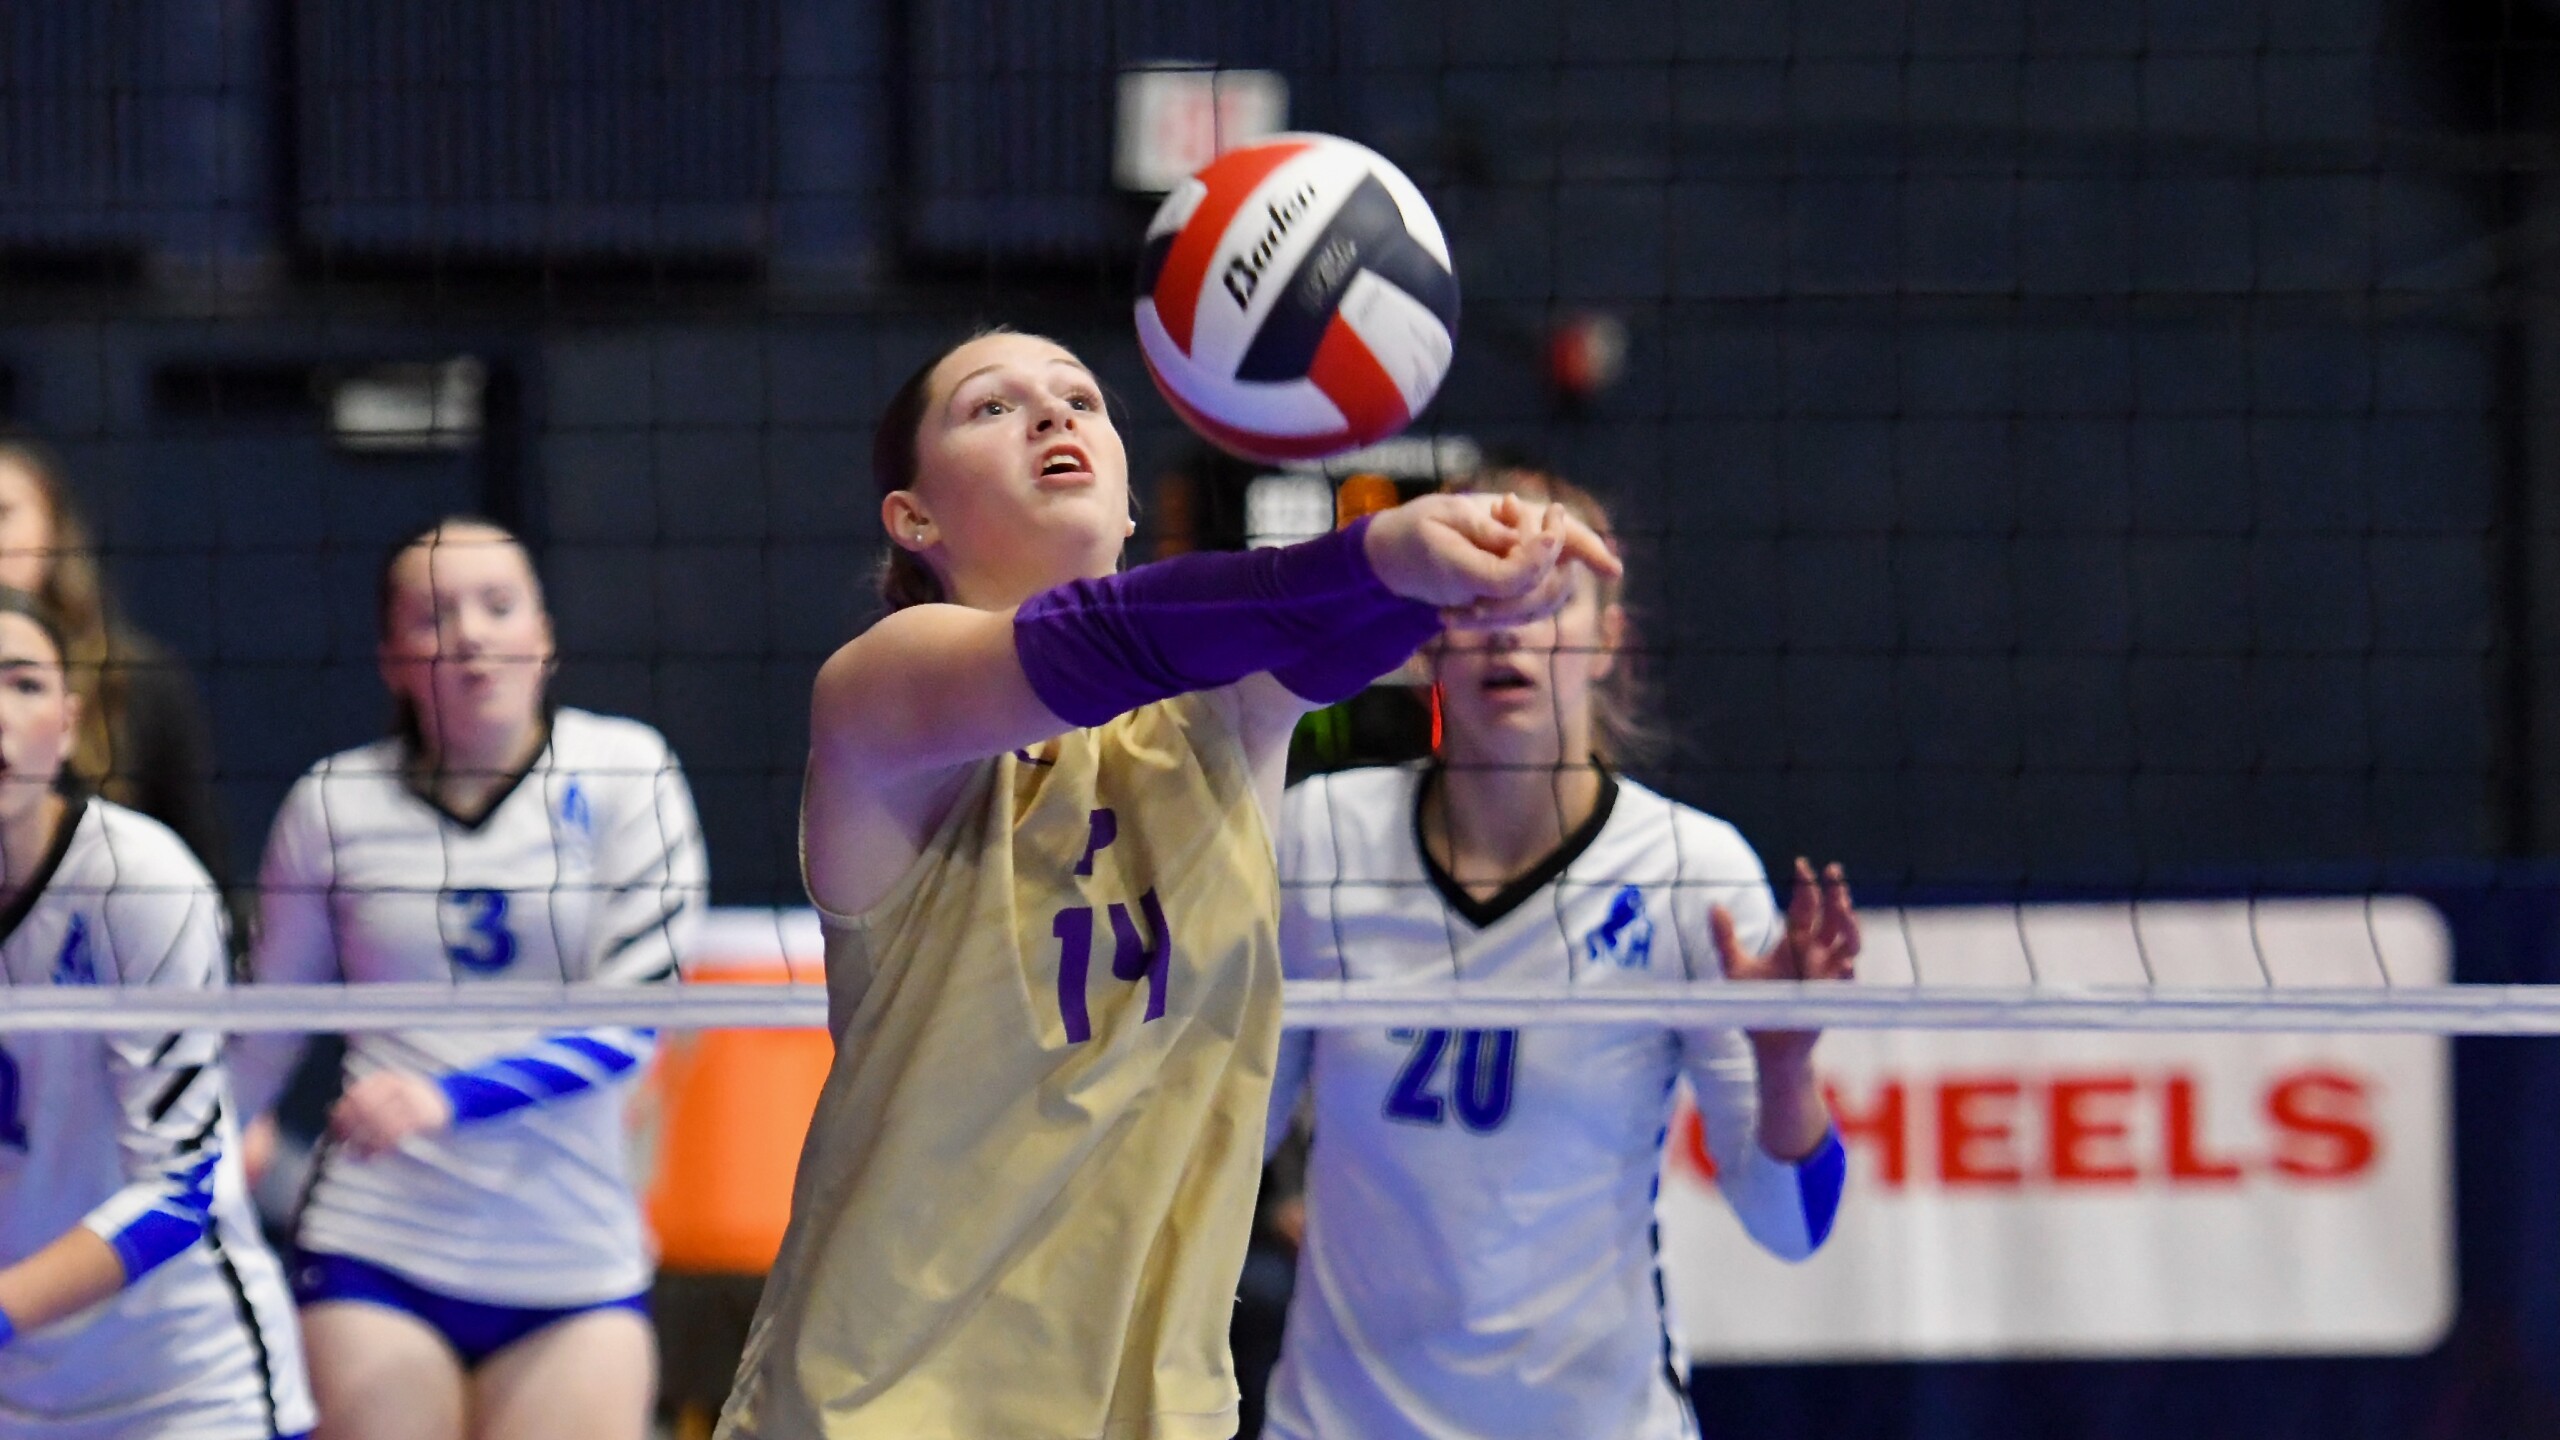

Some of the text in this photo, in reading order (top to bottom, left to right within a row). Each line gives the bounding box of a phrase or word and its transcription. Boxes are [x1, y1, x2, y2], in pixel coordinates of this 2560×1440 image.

[1223, 182, 1316, 312] Baden
[1074, 808, 1117, 876] P
[447, 885, 517, 974] 3
[1052, 886, 1171, 1044] 14
[1382, 1027, 1519, 1135] 20
[1672, 1070, 2380, 1190] HEELS
